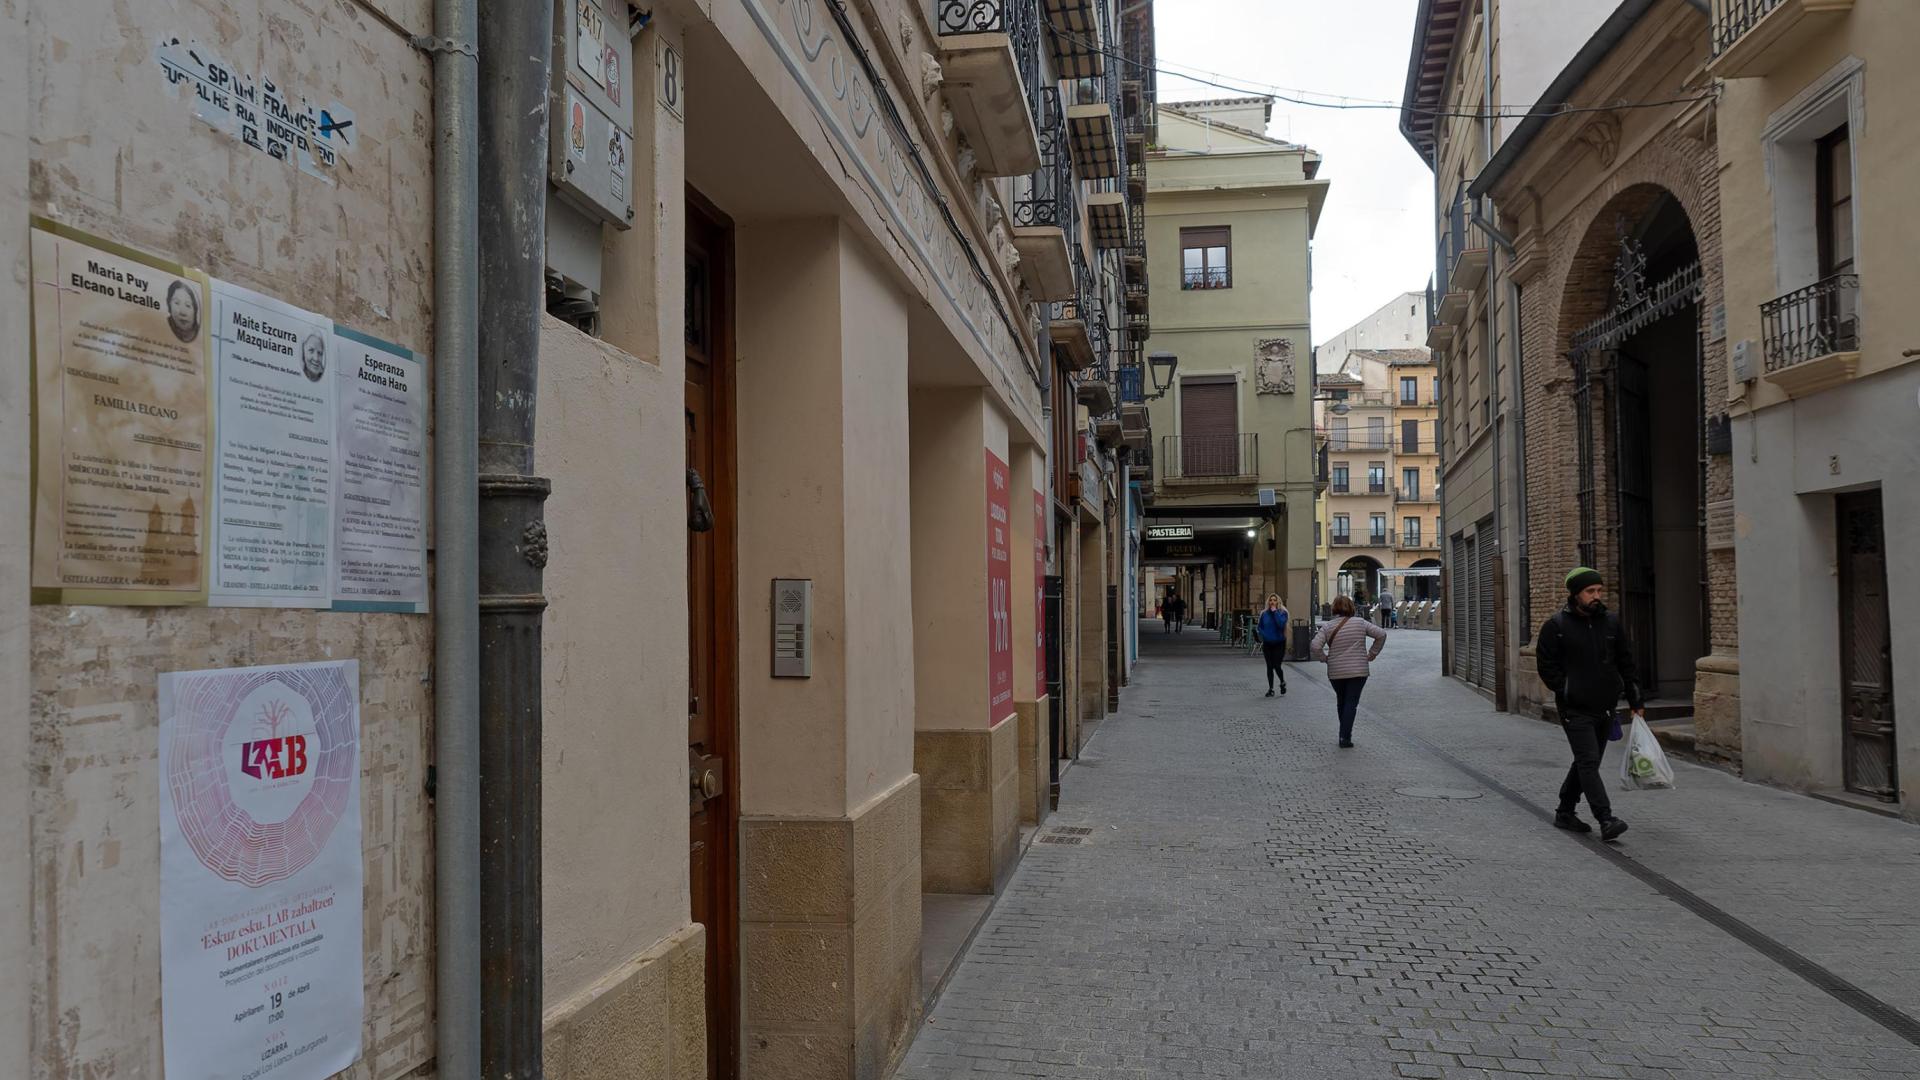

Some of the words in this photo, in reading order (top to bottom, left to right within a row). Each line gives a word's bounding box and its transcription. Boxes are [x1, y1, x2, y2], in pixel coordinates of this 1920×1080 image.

[664, 47, 676, 106] 8
[71, 273, 114, 297] Elcano
[118, 287, 160, 310] Lacalle
[126, 273, 148, 292] Puy
[233, 312, 260, 332] Maite
[262, 322, 296, 342] Ezcurra
[237, 329, 293, 356] Mazquiaran
[364, 354, 405, 377] Esperanza
[358, 367, 386, 386] Azcona
[389, 377, 407, 392] Haro
[94, 394, 136, 412] FAMILIA
[138, 404, 178, 420] ELCANO
[1152, 528, 1192, 536] PASTELERIA
[242, 734, 307, 780] LAB
[268, 909, 289, 928] LAB
[227, 918, 316, 960] DOKUMENTALA
[270, 992, 282, 1010] 19
[288, 990, 296, 998] de
